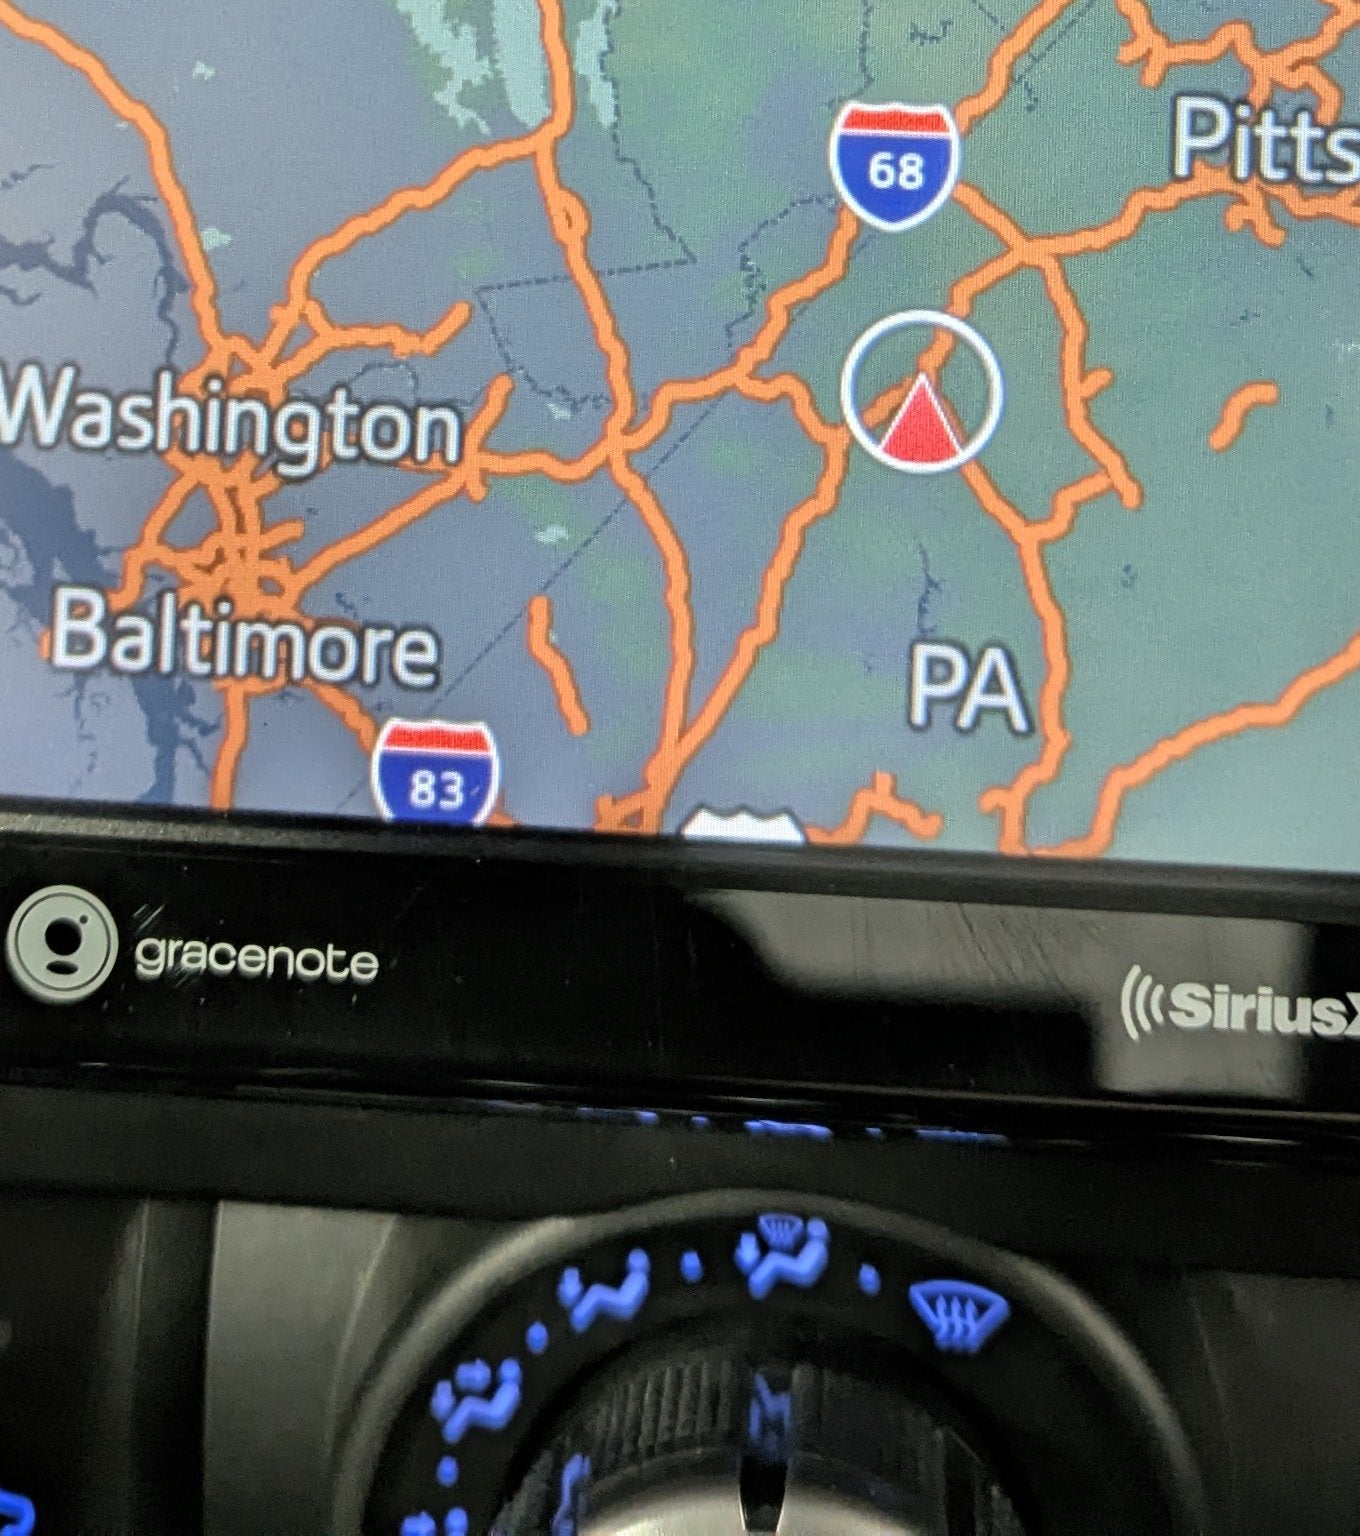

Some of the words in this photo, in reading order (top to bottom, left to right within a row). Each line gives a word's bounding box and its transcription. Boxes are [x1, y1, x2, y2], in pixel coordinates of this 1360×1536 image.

[867, 148, 924, 192] 68
[51, 586, 440, 687] Baltimore
[910, 642, 1032, 734] PA
[408, 768, 465, 811] 83
[135, 937, 380, 983] gracenote
